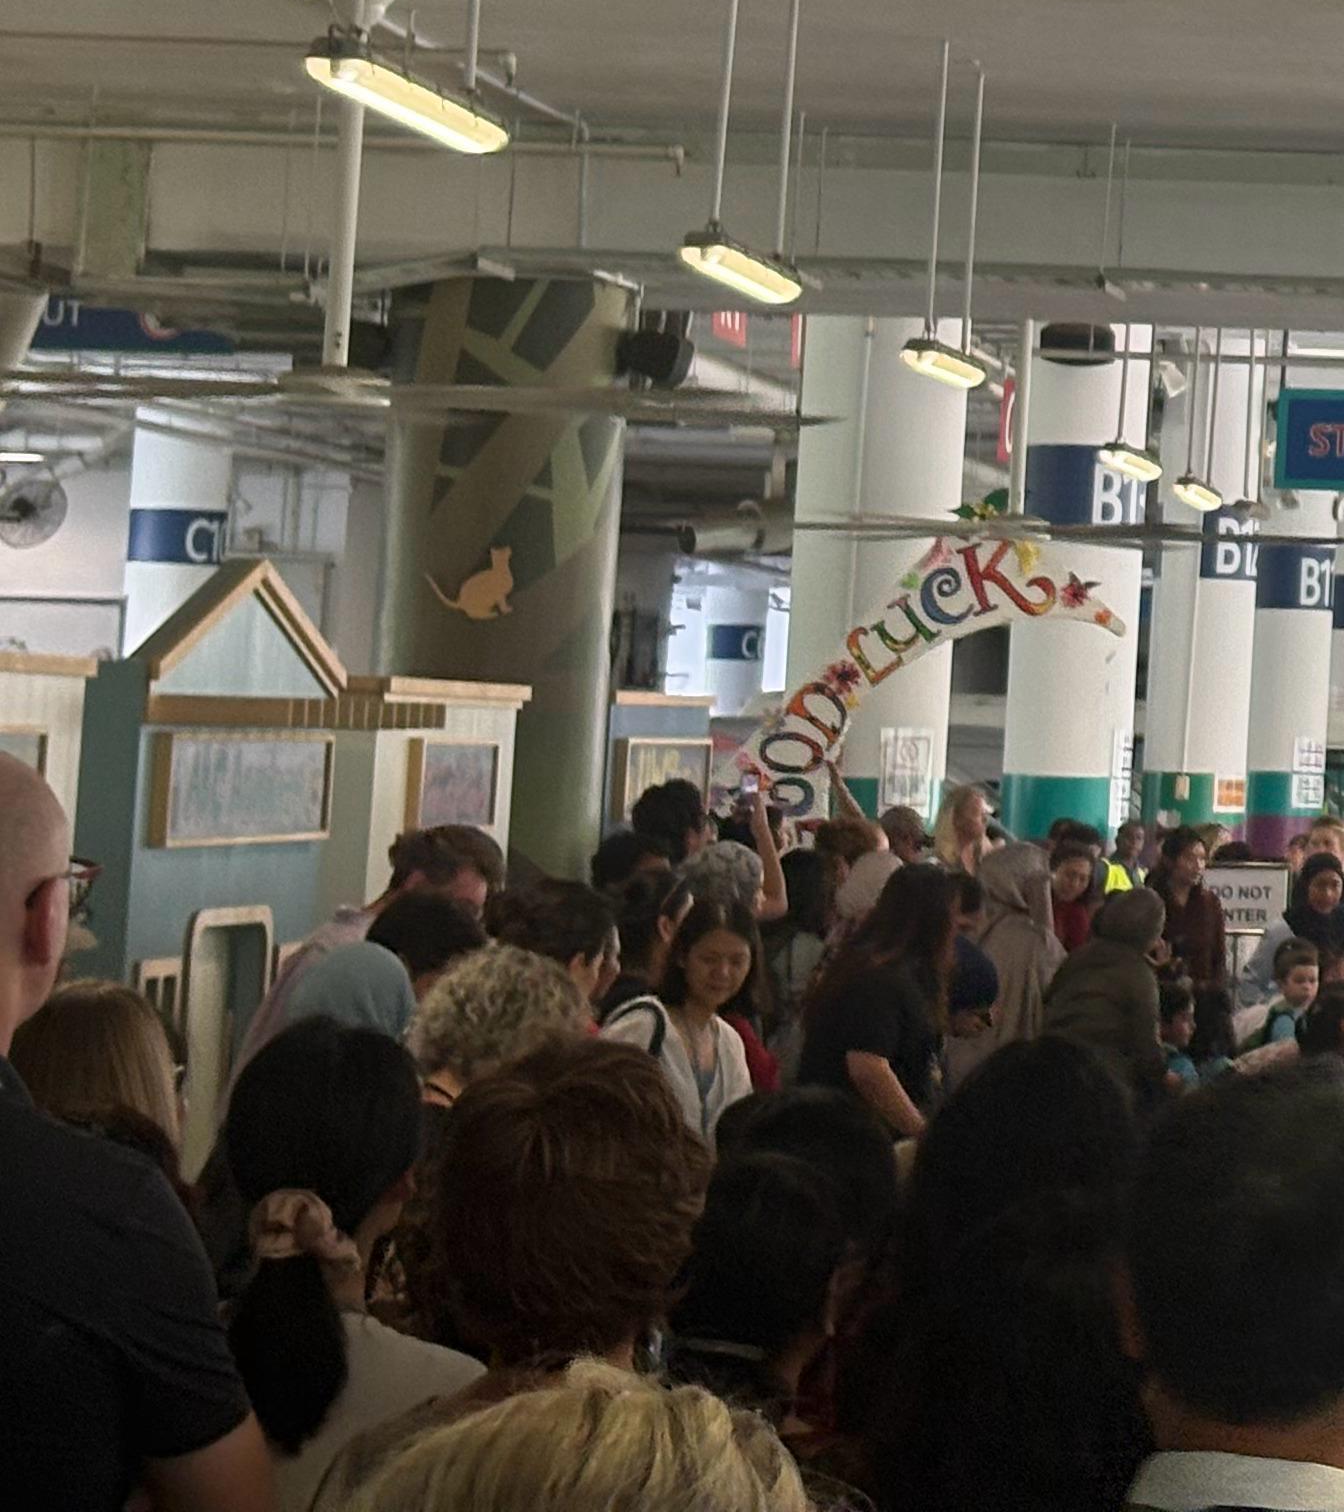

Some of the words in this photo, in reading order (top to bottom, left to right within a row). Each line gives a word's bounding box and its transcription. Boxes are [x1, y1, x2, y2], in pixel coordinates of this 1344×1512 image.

[1092, 463, 1147, 525] B1
[846, 536, 1057, 688] LUCK
[1238, 886, 1271, 900] NOT
[1223, 908, 1267, 922] NTER
